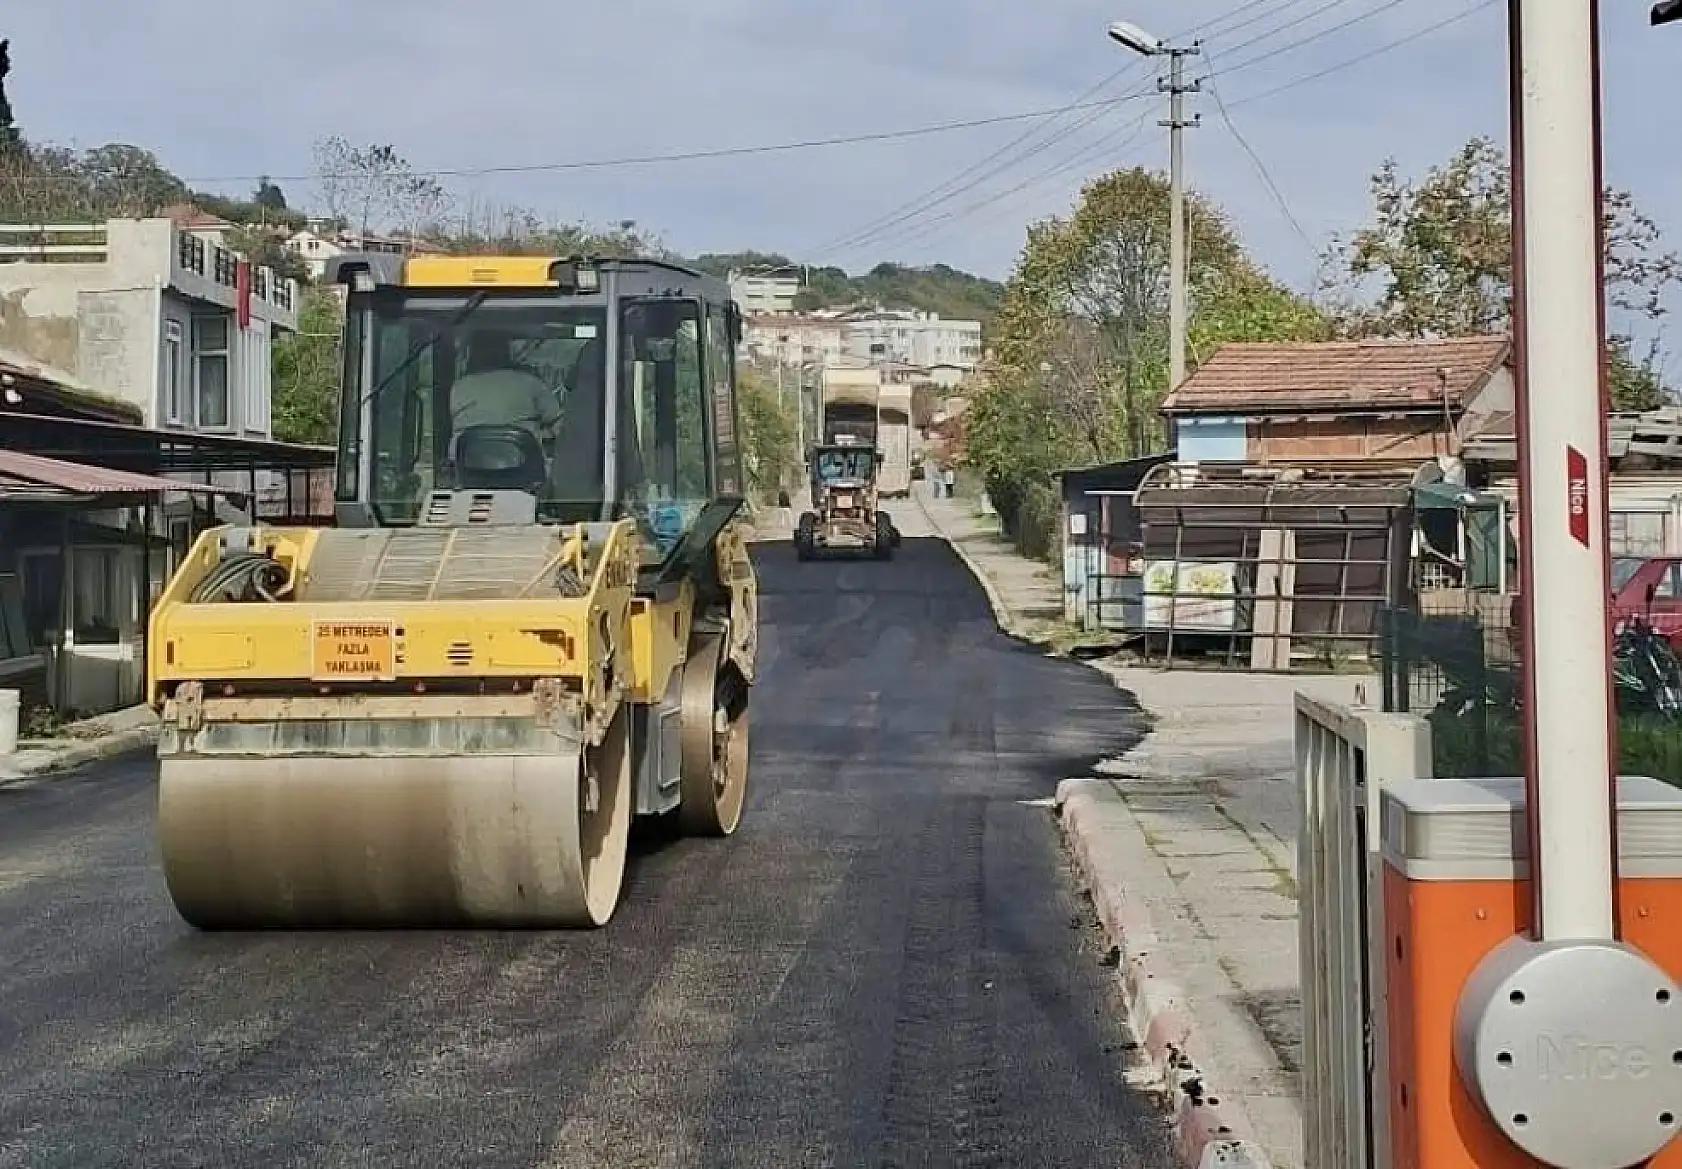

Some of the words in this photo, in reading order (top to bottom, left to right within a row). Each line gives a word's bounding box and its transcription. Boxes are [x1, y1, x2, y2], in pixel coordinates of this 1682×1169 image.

[1571, 478, 1586, 514] Nice
[333, 626, 389, 637] METREDEN
[337, 643, 369, 655] FAZLA
[1536, 1033, 1653, 1079] Nice
